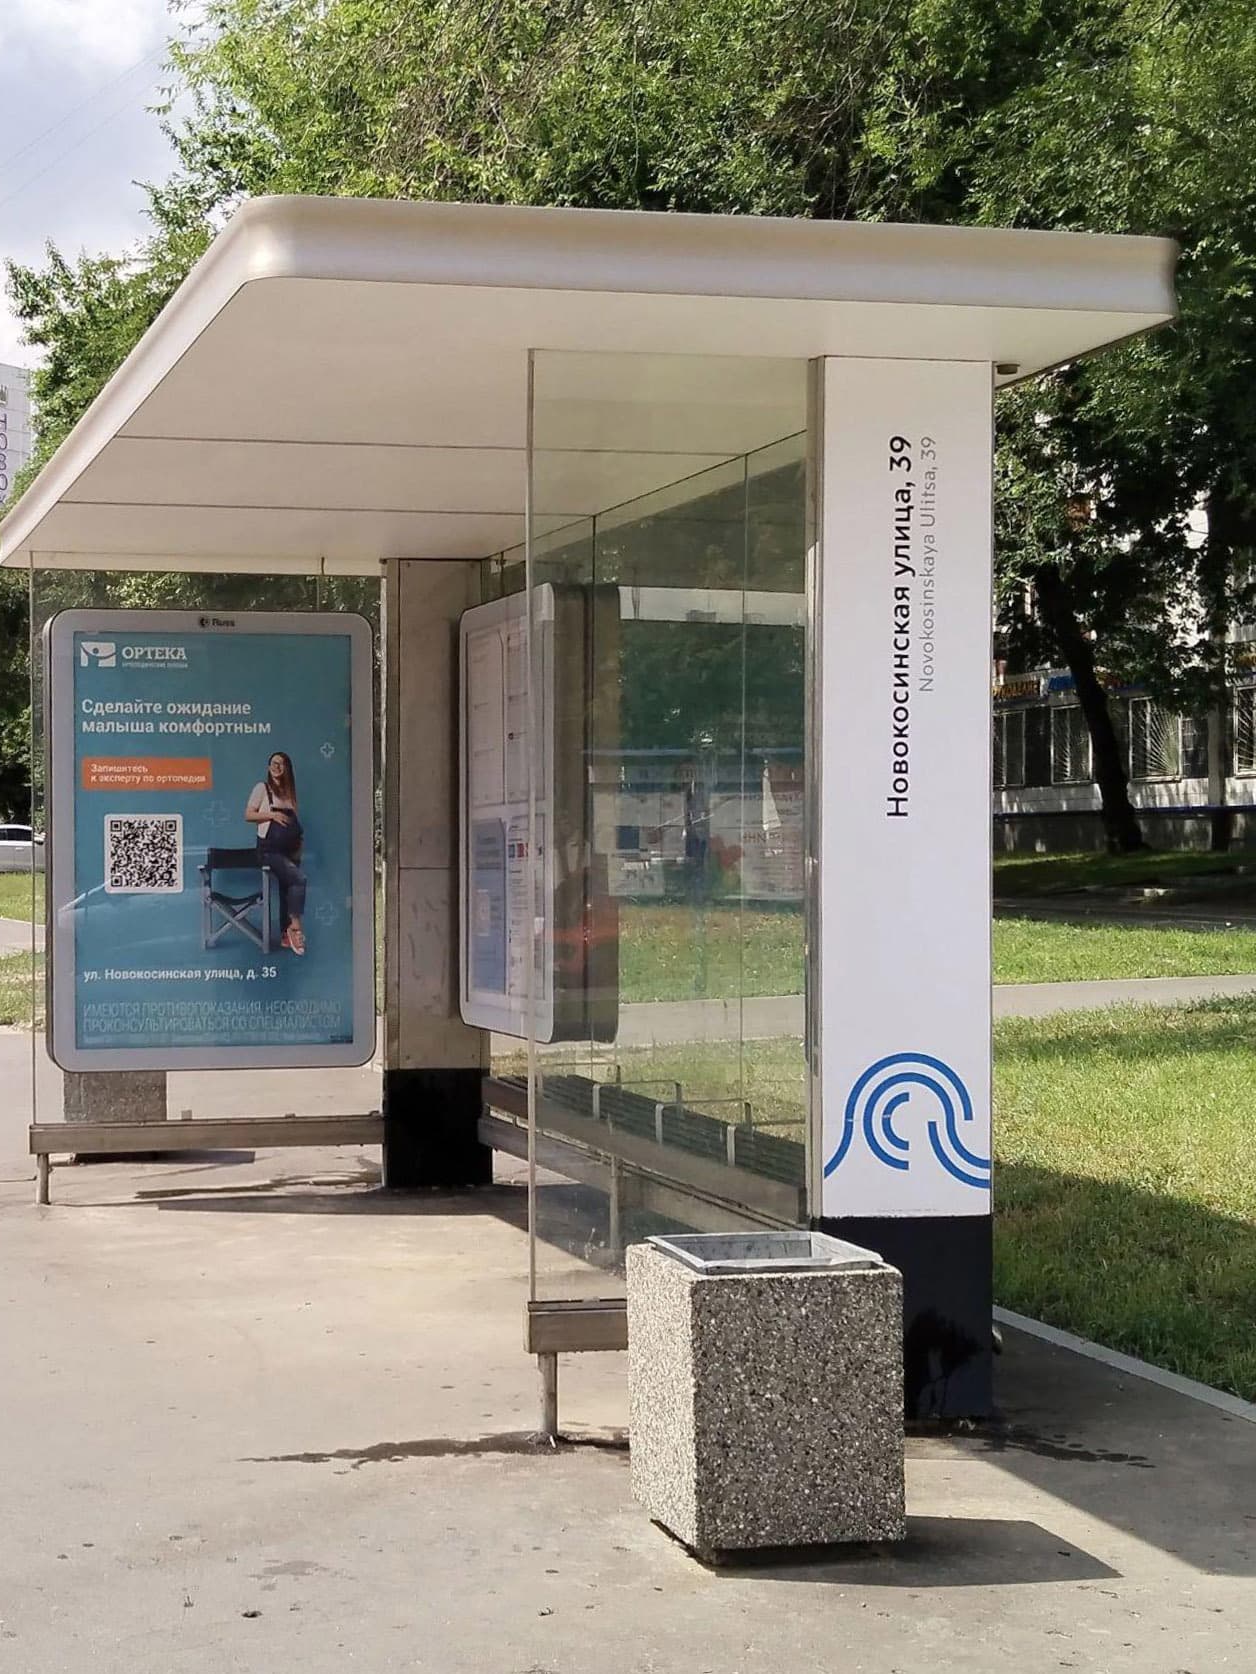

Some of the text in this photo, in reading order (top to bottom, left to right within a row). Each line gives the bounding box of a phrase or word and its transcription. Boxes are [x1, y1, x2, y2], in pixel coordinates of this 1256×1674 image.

[919, 436, 938, 692] Novokosinskaya Ulitsa, 39
[887, 436, 916, 817] Новокосинская улица, 39
[122, 646, 187, 660] ОРТЕКА
[81, 699, 251, 717] Сделайте ожидание
[82, 719, 271, 736] малыша комфортным
[91, 764, 148, 773] Запишитесь
[99, 775, 140, 784] эксперту
[84, 971, 100, 982] ул.
[105, 969, 201, 980] Новокосинская
[204, 968, 244, 981] улица,
[261, 967, 276, 978] 35
